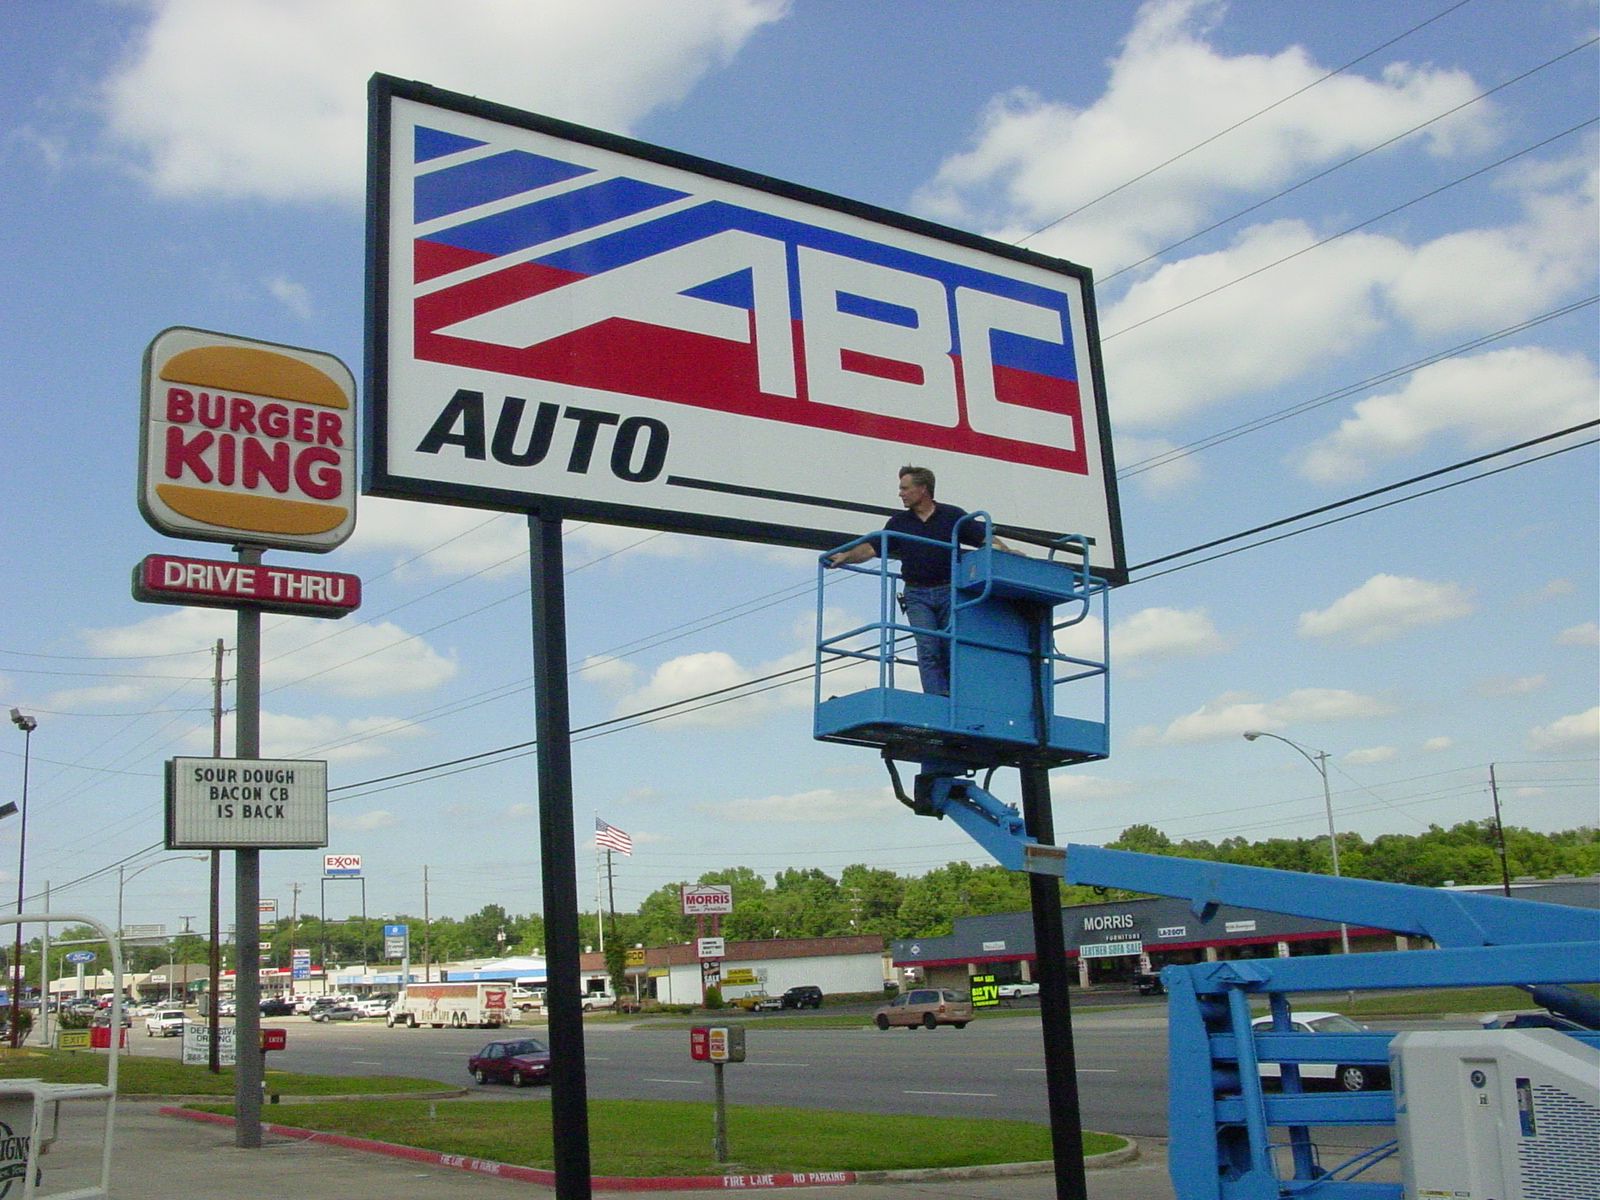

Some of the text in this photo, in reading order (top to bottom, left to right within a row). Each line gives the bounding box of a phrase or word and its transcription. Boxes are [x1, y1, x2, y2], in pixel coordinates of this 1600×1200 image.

[431, 228, 1076, 452] ABC
[166, 387, 343, 447] BURGER
[416, 388, 670, 484] AUTO
[165, 425, 342, 500] KING
[164, 561, 345, 602] DRIVE THRU
[194, 768, 295, 784] SOUR DOUGH
[210, 786, 289, 801] BACON CB
[217, 804, 285, 818] IS BACK
[326, 857, 360, 869] EXXON
[685, 894, 730, 905] MORRIS
[1084, 914, 1134, 931] MORRIS
[1105, 933, 1141, 941] FURNITURE
[1108, 944, 1125, 955] SOFA
[1126, 942, 1141, 954] SALE
[704, 975, 719, 983] SALE
[983, 986, 998, 999] TV
[63, 1035, 85, 1043] EXIT
[723, 1171, 846, 1187] FIRE LANE NO PARKING
